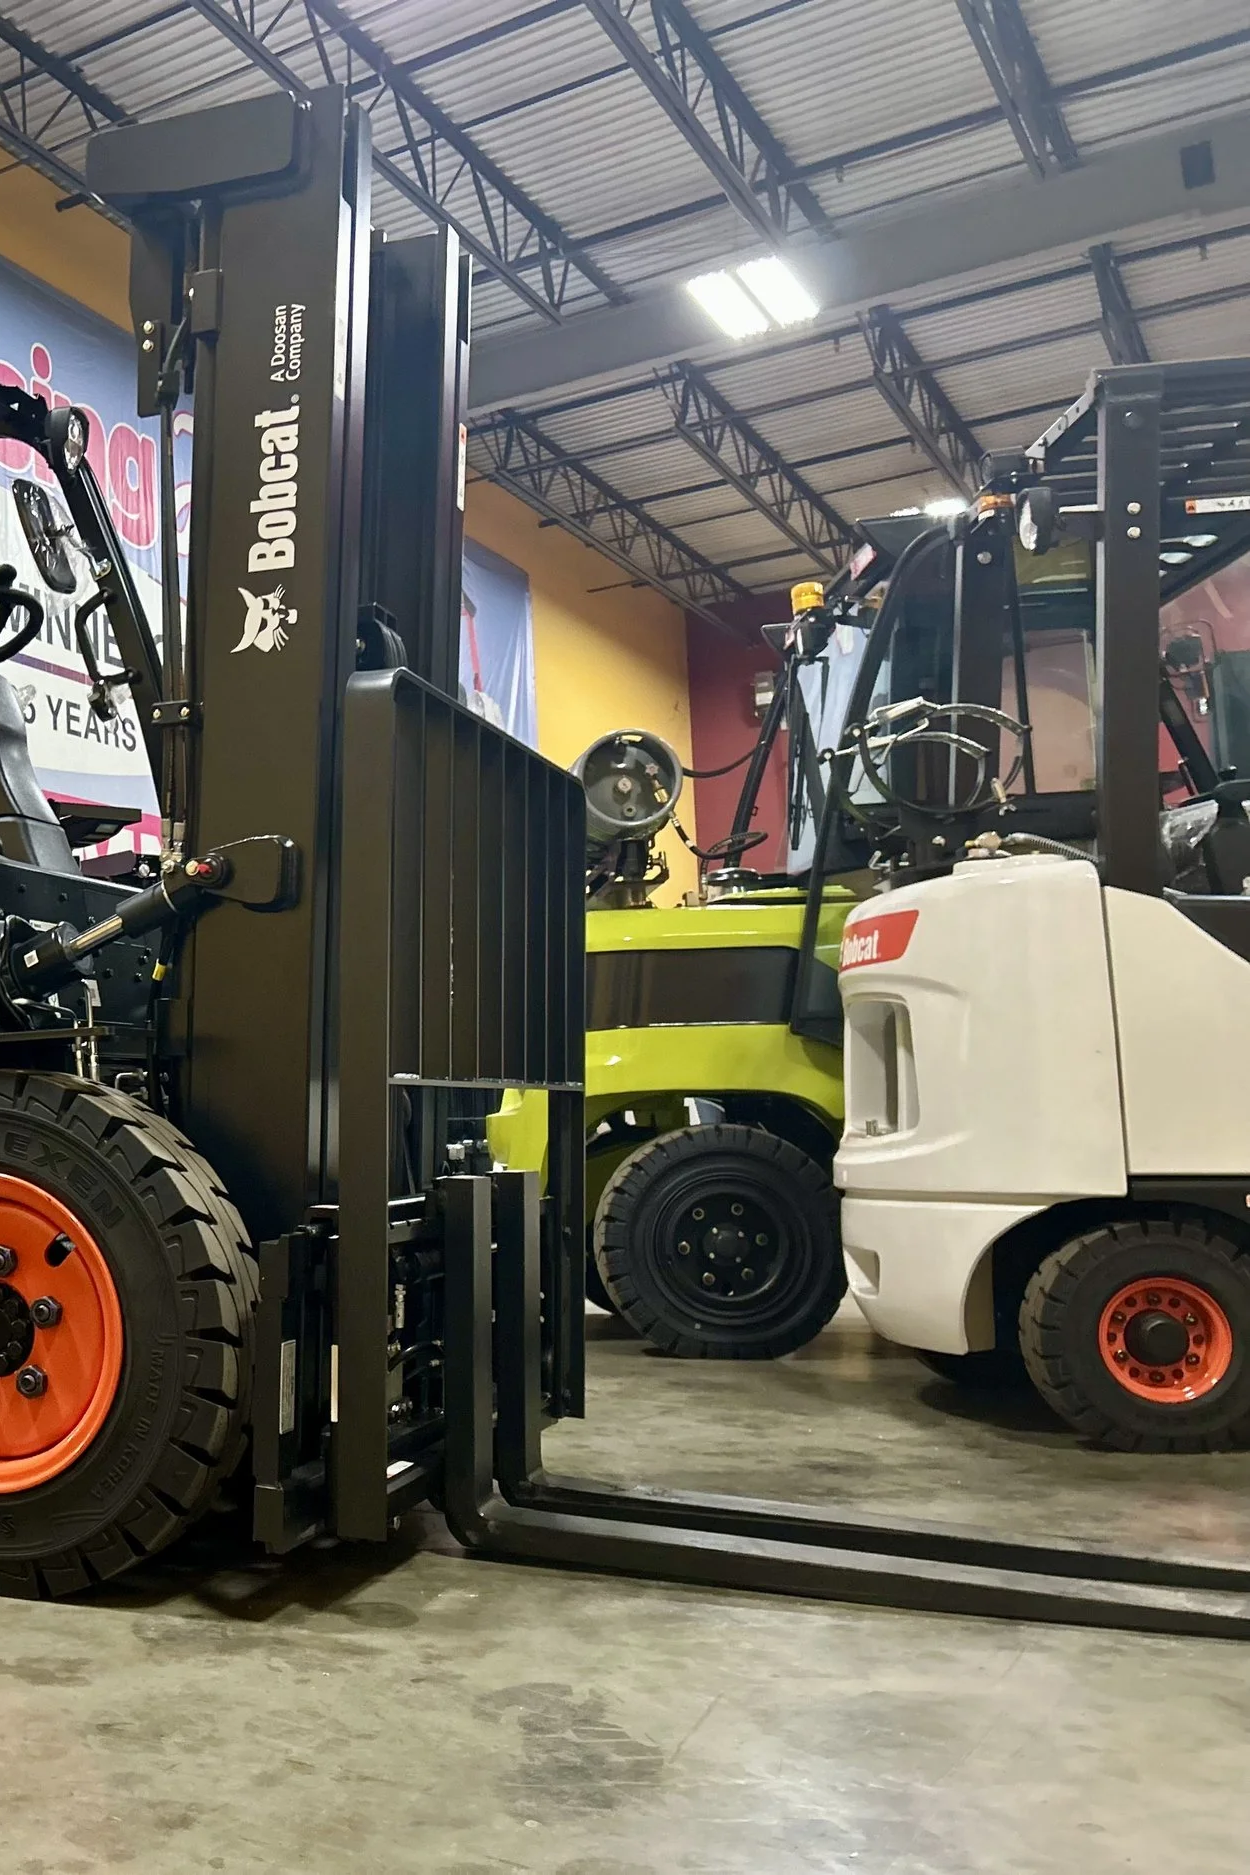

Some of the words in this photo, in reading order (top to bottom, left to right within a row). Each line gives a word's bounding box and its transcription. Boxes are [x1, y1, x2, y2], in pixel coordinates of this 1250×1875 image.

[270, 304, 287, 367] Doosan
[285, 303, 306, 381] Company
[270, 368, 285, 382] A
[46, 694, 137, 752] YEARS
